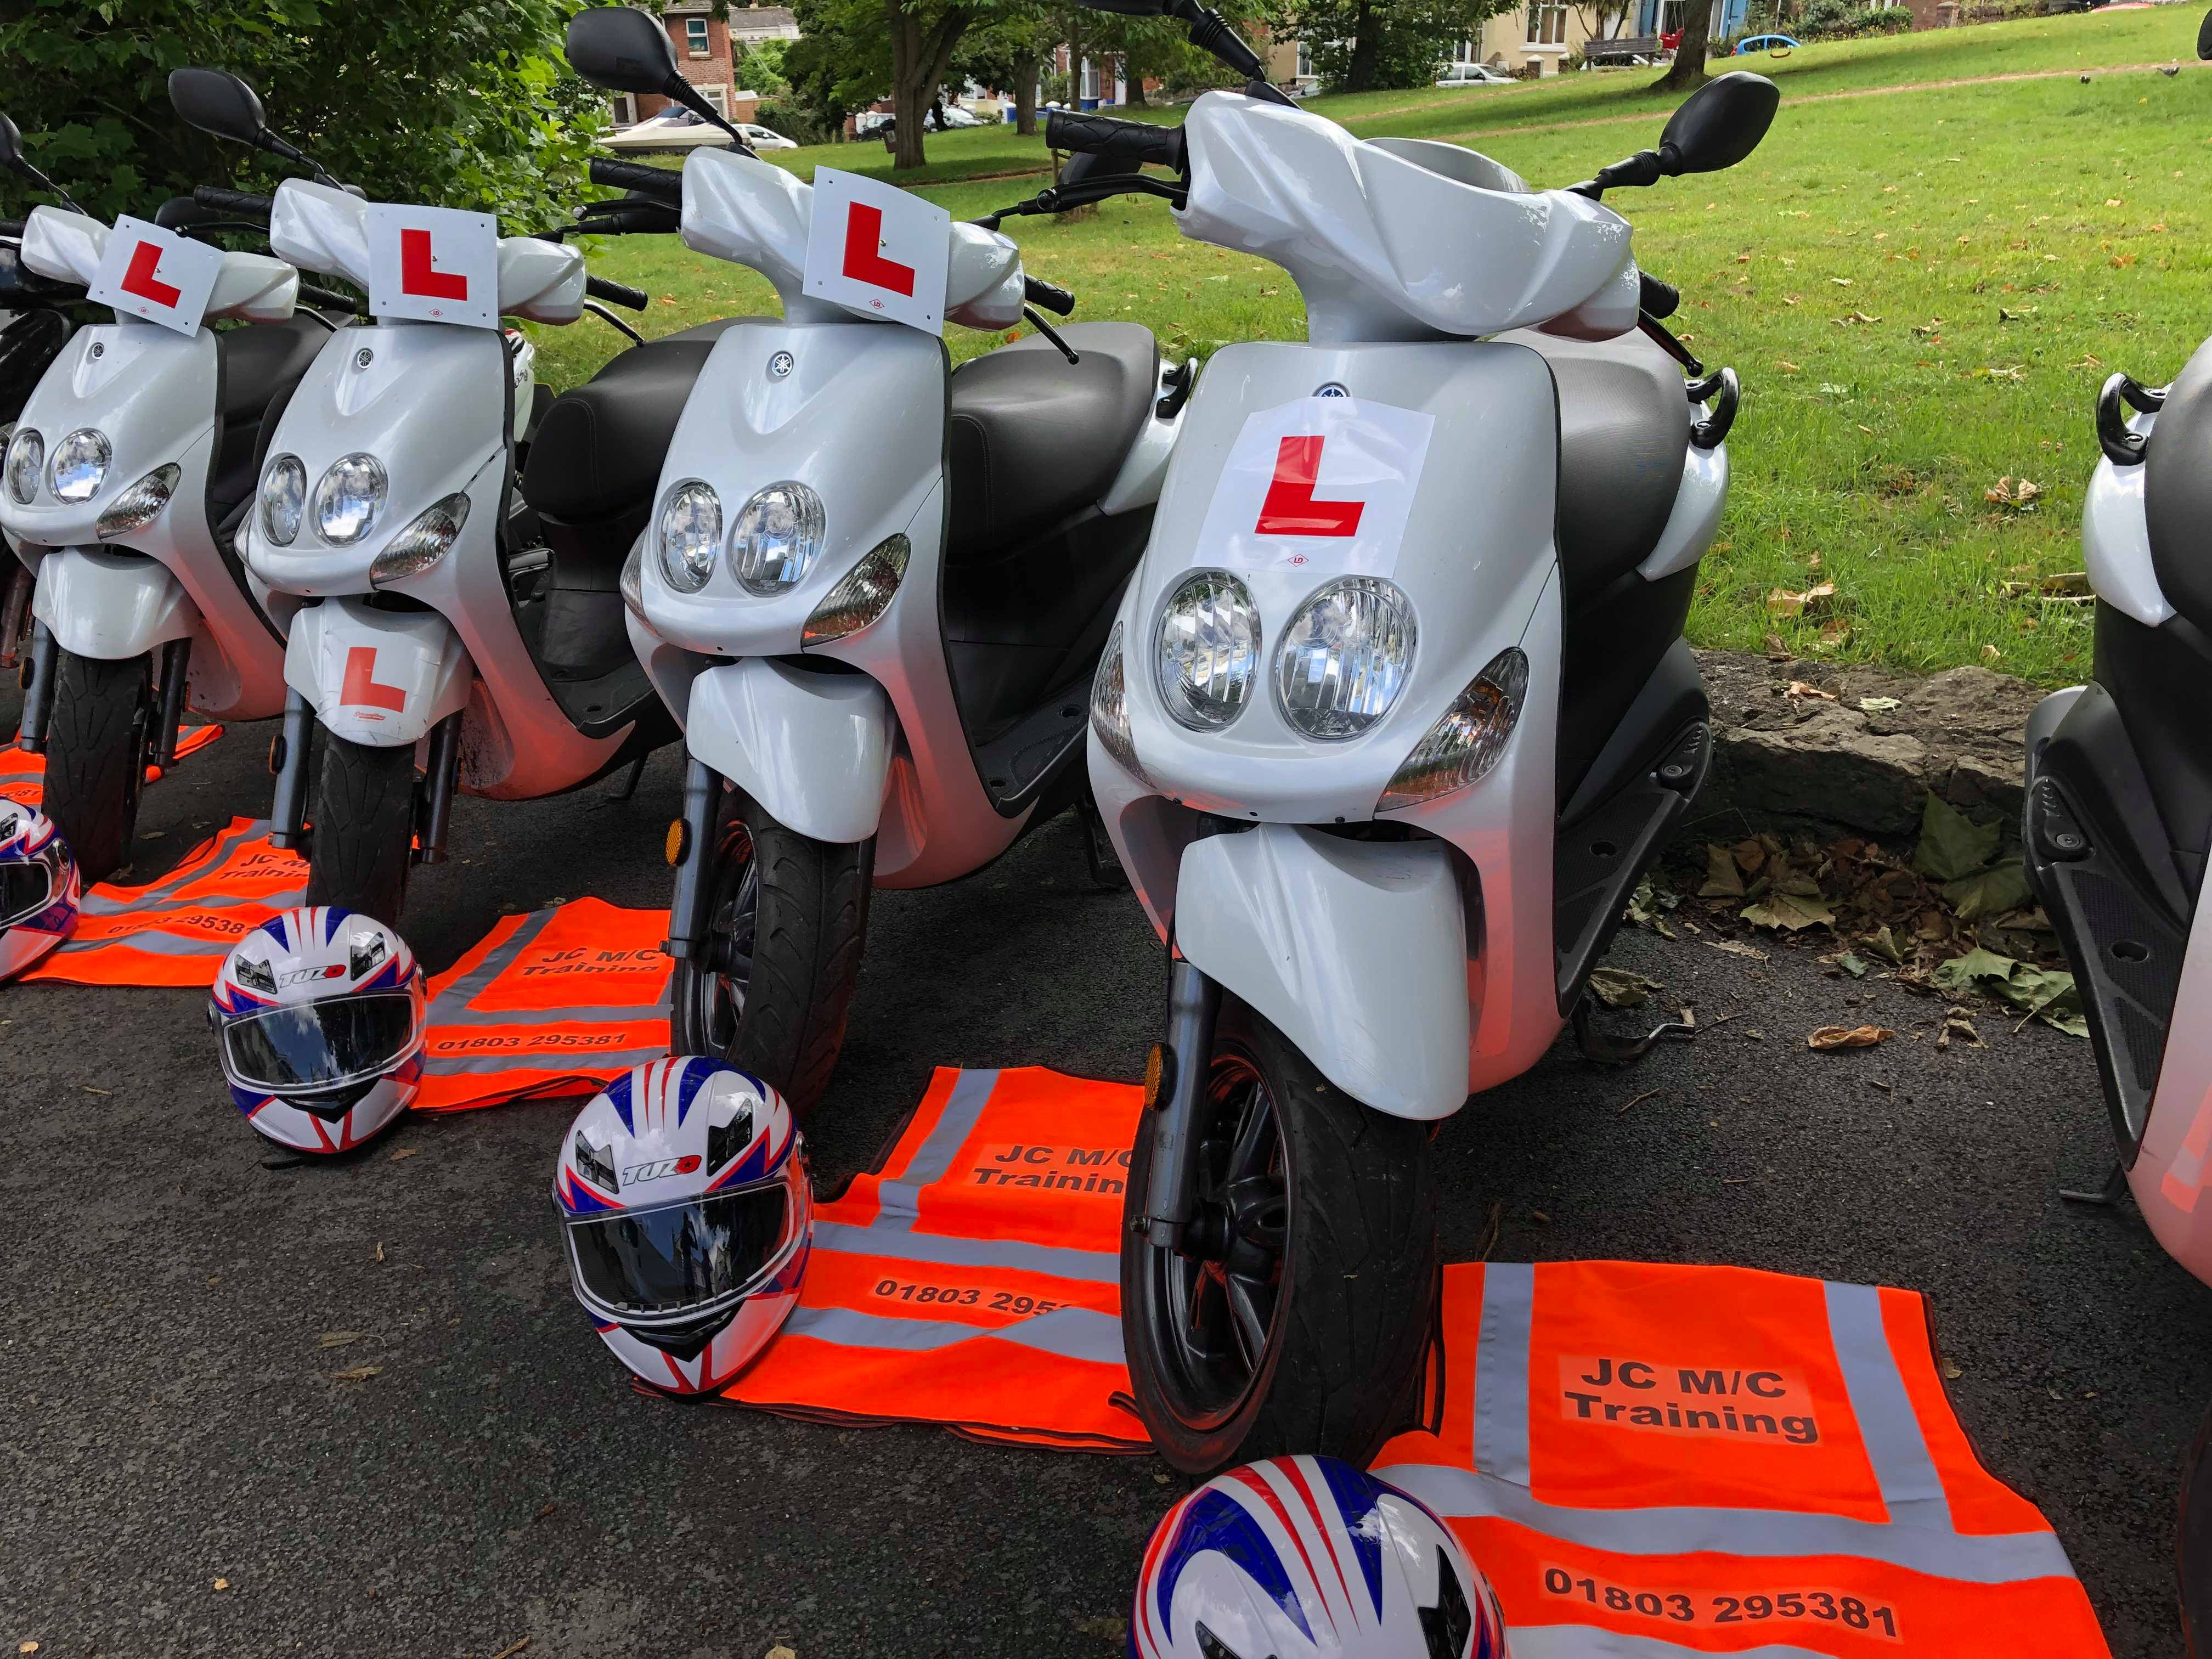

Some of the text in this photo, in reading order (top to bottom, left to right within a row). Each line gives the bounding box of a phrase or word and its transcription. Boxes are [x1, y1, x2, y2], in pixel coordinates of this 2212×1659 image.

[400, 228, 467, 301] L
[842, 201, 916, 297] L
[121, 241, 182, 309] L
[1254, 435, 1365, 537] L
[340, 646, 407, 714] L
[219, 866, 309, 879] Trainin
[240, 854, 279, 867] JC
[542, 947, 660, 962] JC M/C
[437, 1034, 627, 1049] 01803 295381
[995, 1145, 1054, 1164] JC
[974, 1167, 1128, 1194] Trainin
[874, 1279, 1072, 1316] 01803 295
[1581, 1358, 1786, 1398] JC M/C
[1564, 1391, 1819, 1444] Training
[1544, 1567, 1897, 1638] 01803 295381
